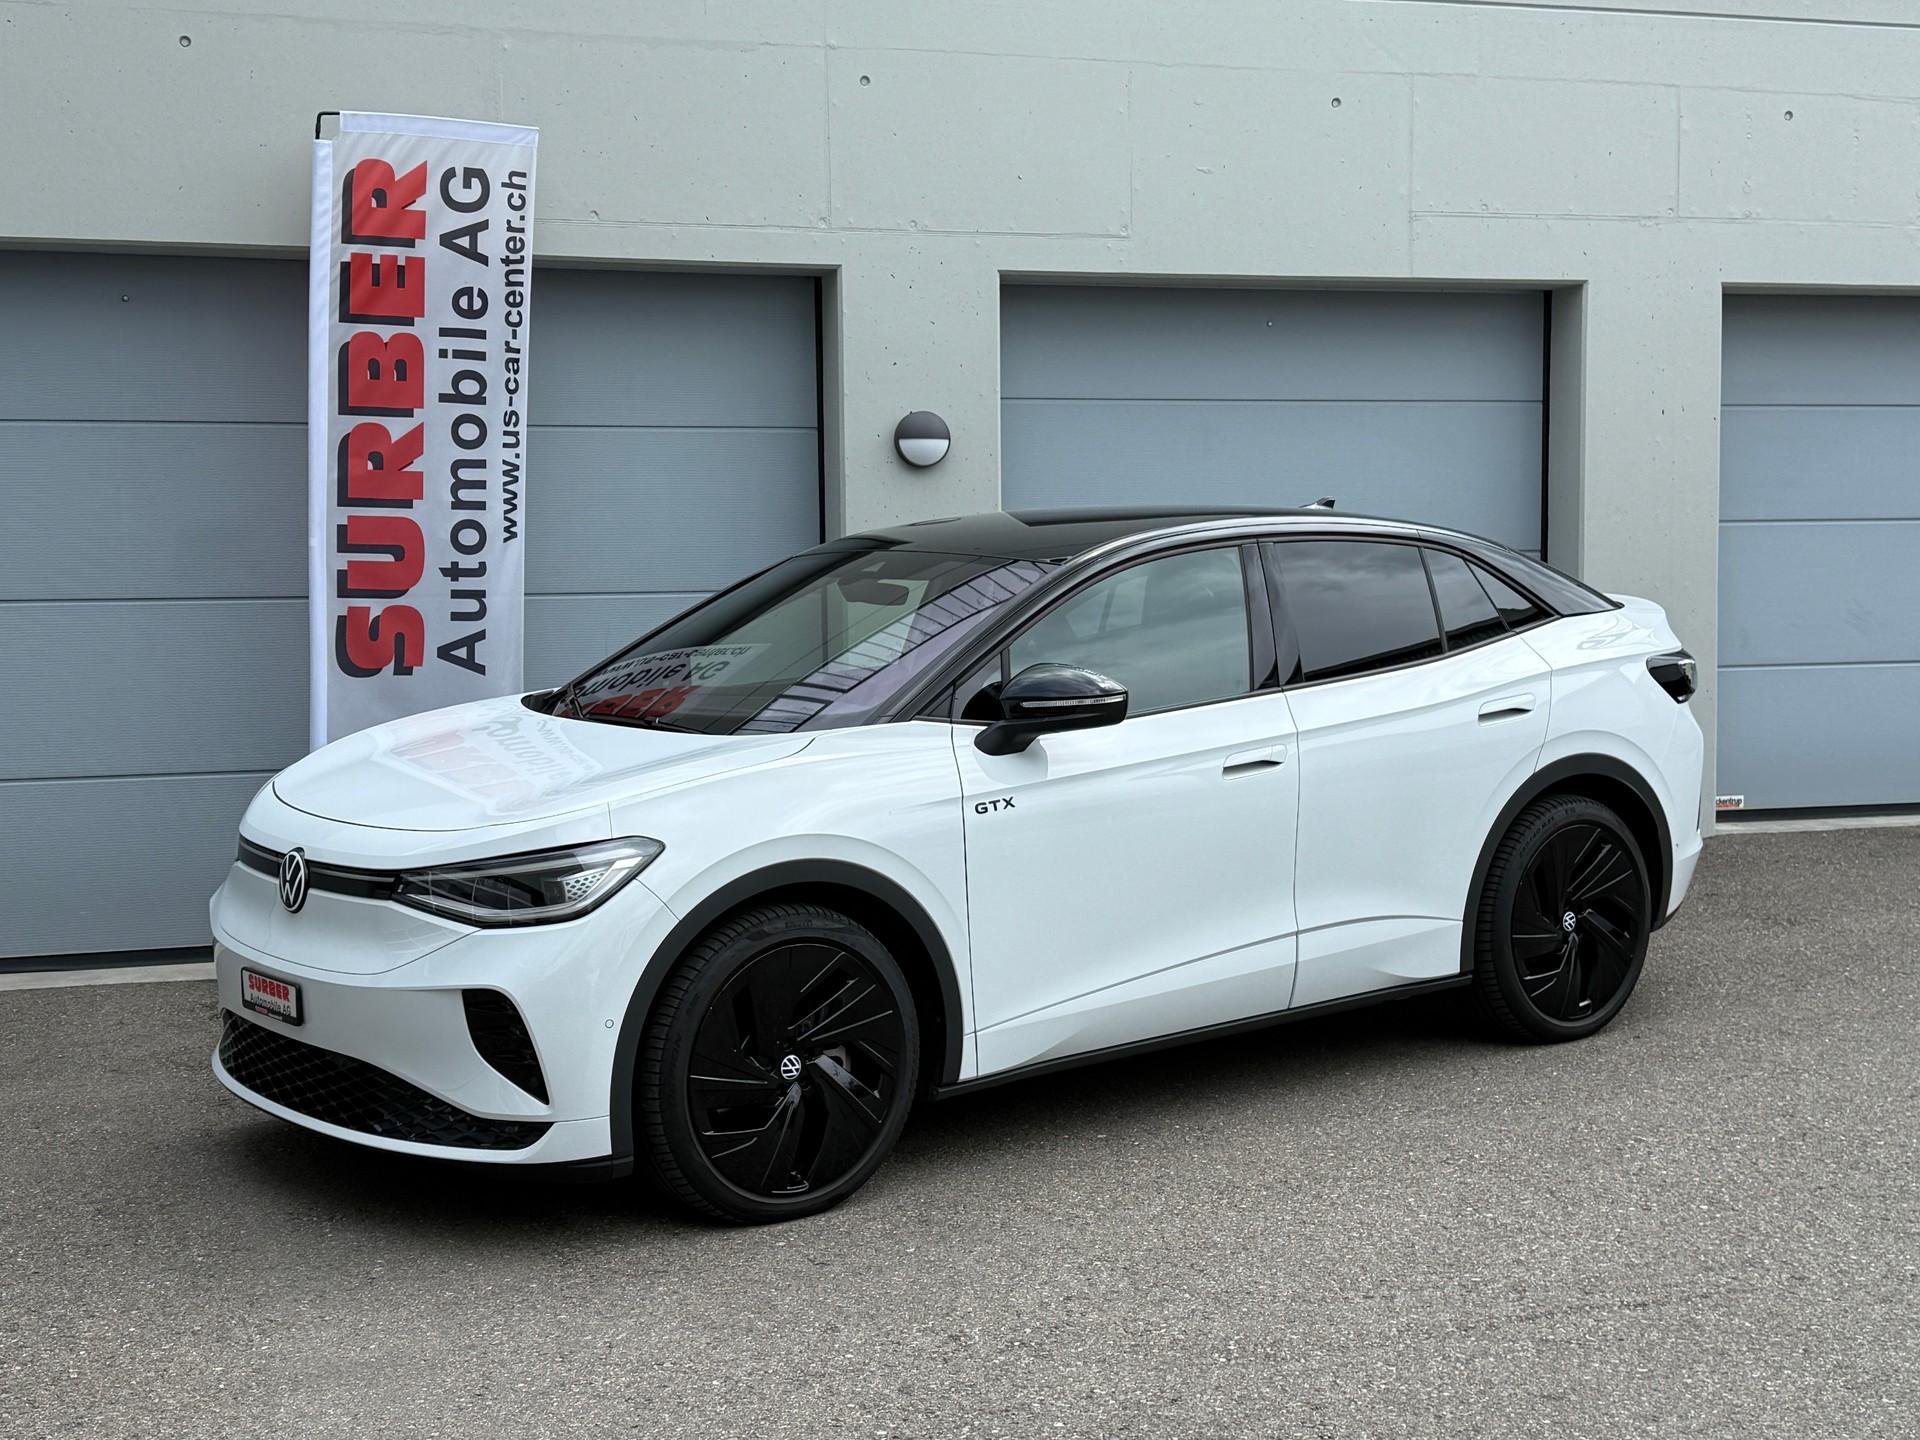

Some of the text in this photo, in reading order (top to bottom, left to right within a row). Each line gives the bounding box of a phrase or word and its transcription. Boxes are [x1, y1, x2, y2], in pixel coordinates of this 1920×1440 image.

[335, 158, 427, 678] SURBER
[437, 166, 490, 676] Automobile AG
[500, 170, 528, 543] www.us-car-center.ch
[974, 796, 1016, 815] GTX
[248, 973, 290, 1003] SURBER
[282, 1004, 292, 1016] AG
